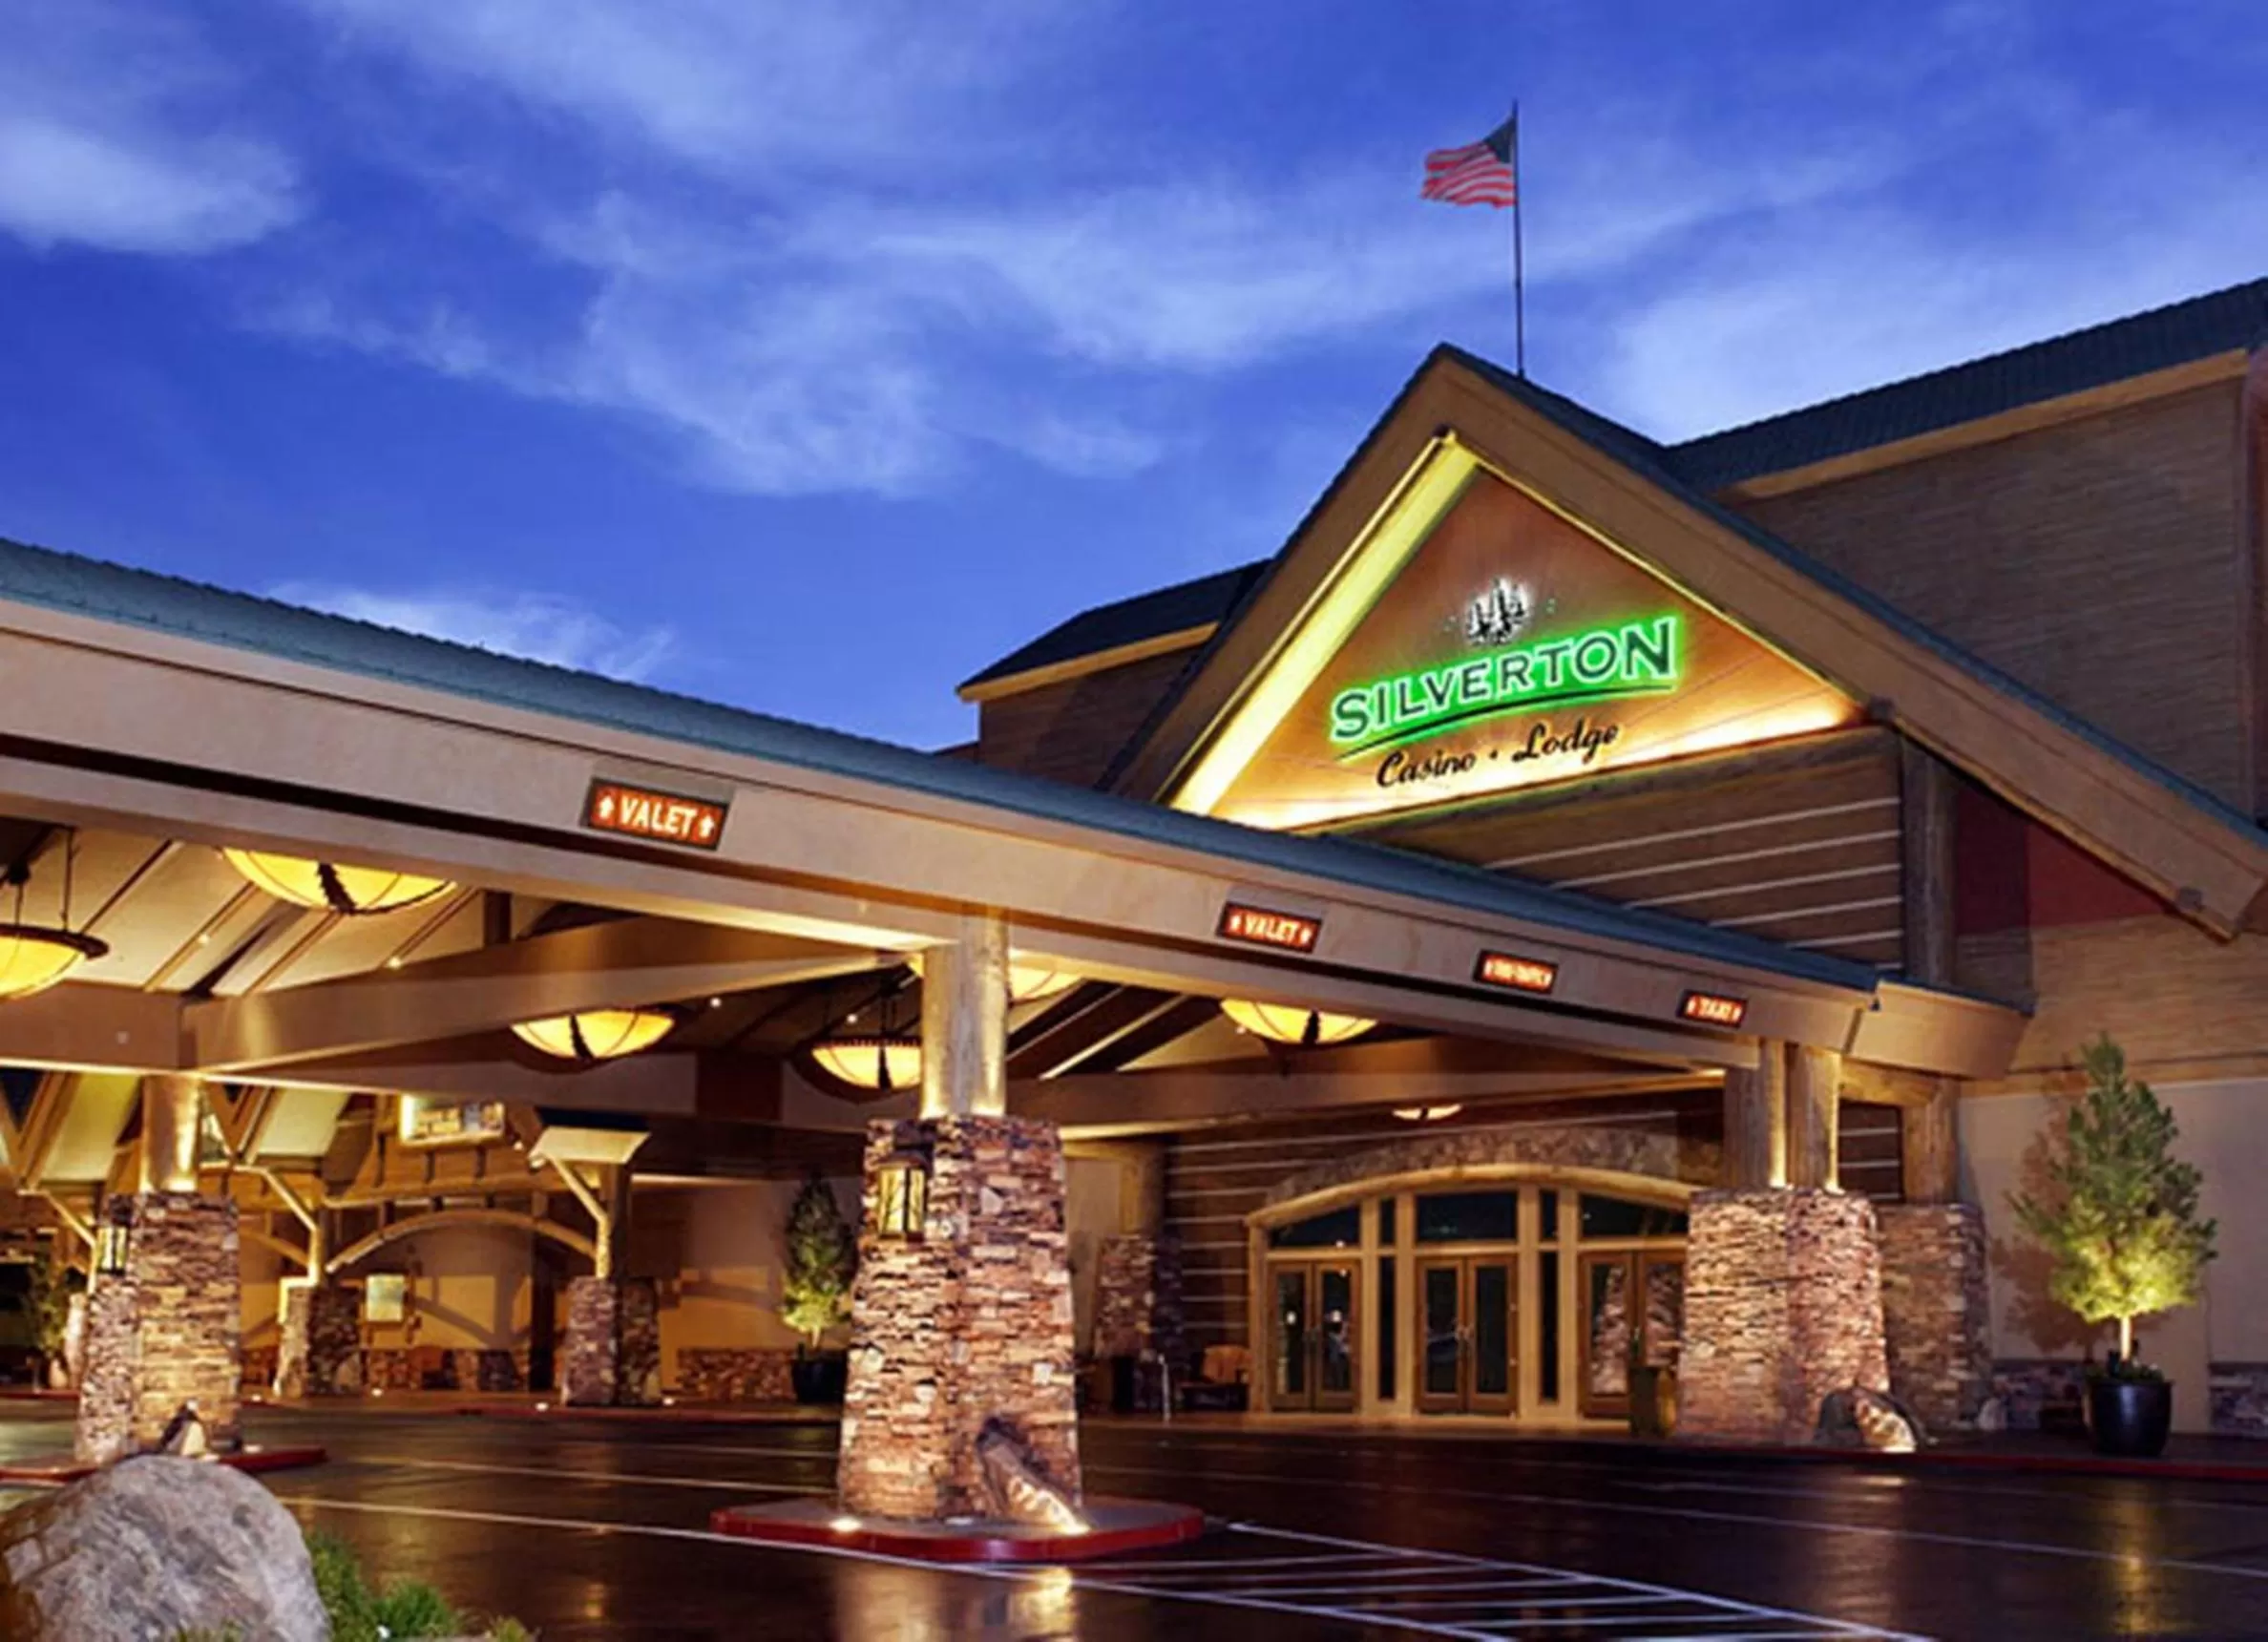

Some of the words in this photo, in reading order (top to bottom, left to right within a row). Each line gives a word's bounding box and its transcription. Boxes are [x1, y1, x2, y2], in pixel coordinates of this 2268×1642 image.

[1332, 618, 1675, 740] SILVERTON
[1376, 750, 1477, 788] Casino
[1511, 719, 1620, 764] Lodge
[620, 795, 698, 838] VALET
[1246, 915, 1299, 944] VALET
